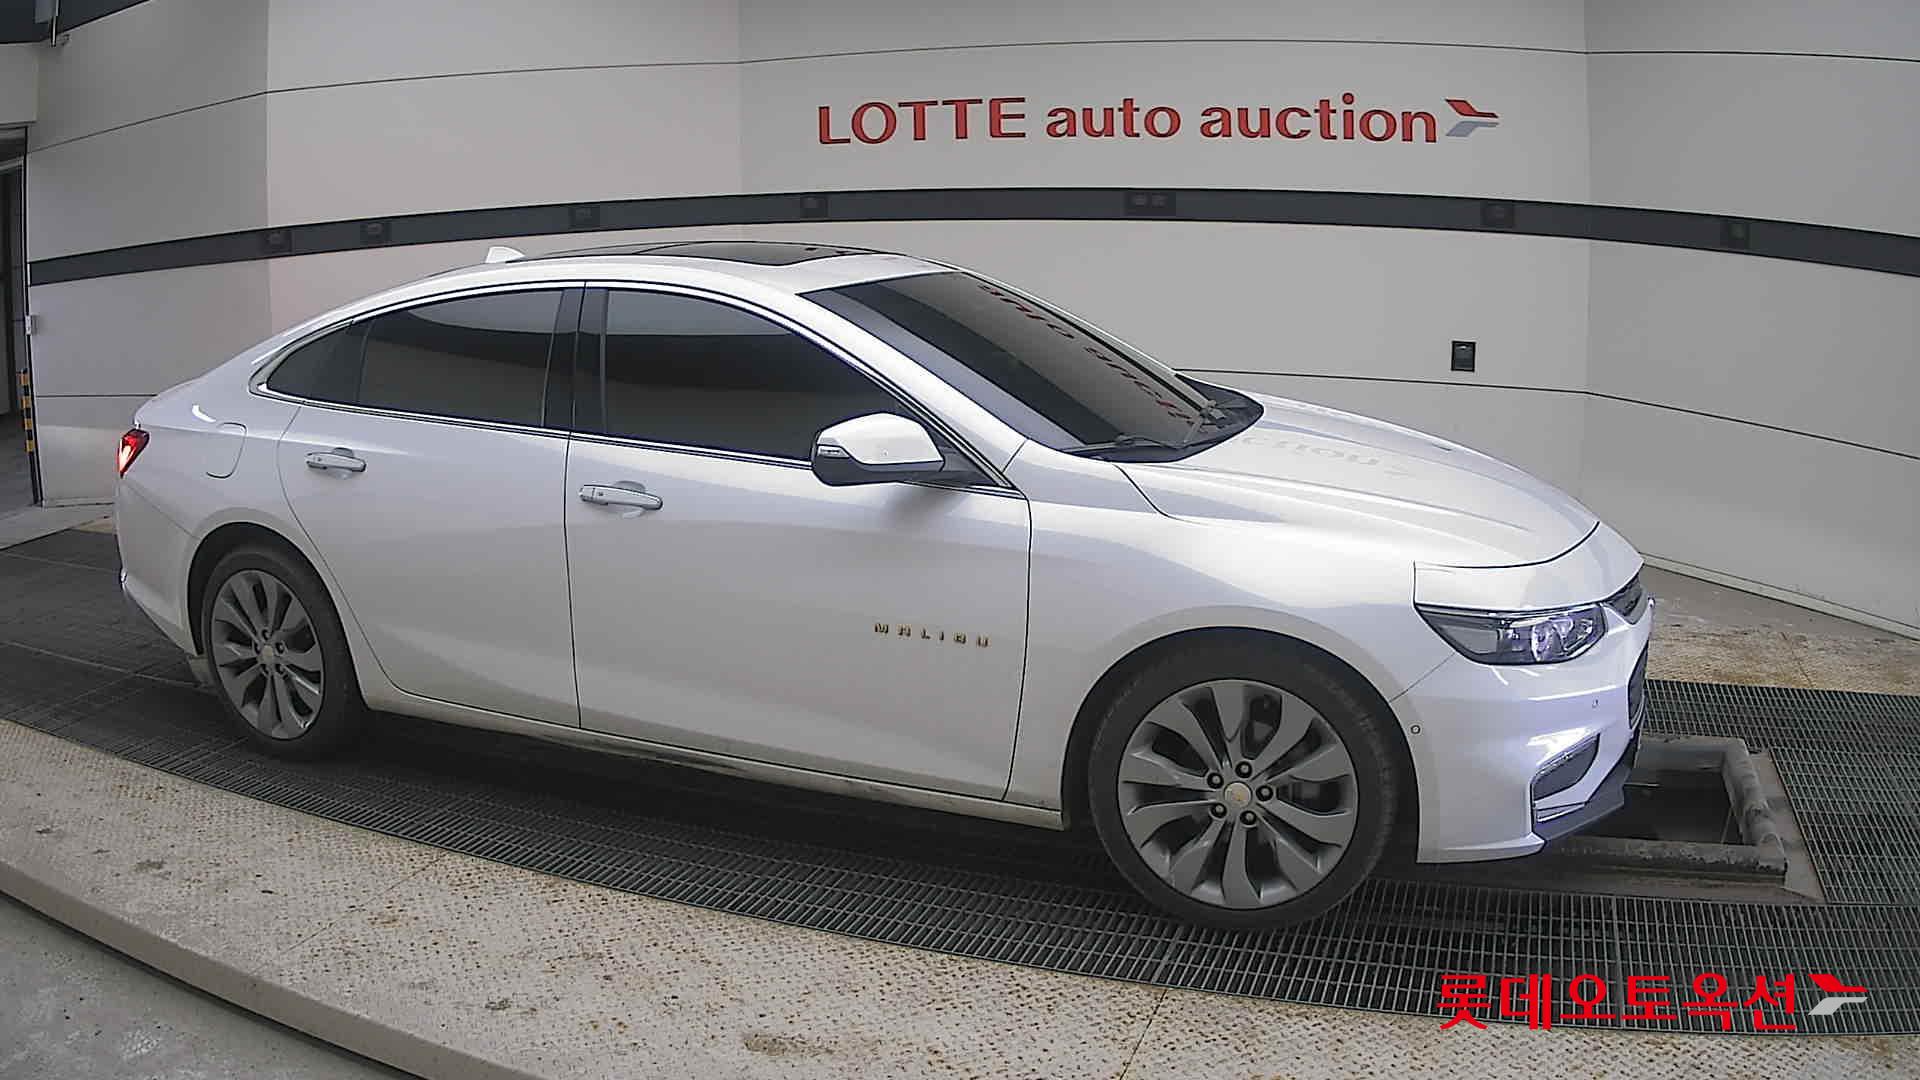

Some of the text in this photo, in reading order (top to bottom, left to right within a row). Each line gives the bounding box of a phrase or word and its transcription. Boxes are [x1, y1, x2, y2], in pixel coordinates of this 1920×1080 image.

[819, 93, 1438, 145] LOTTE auto auction
[873, 622, 991, 648] MALIBU
